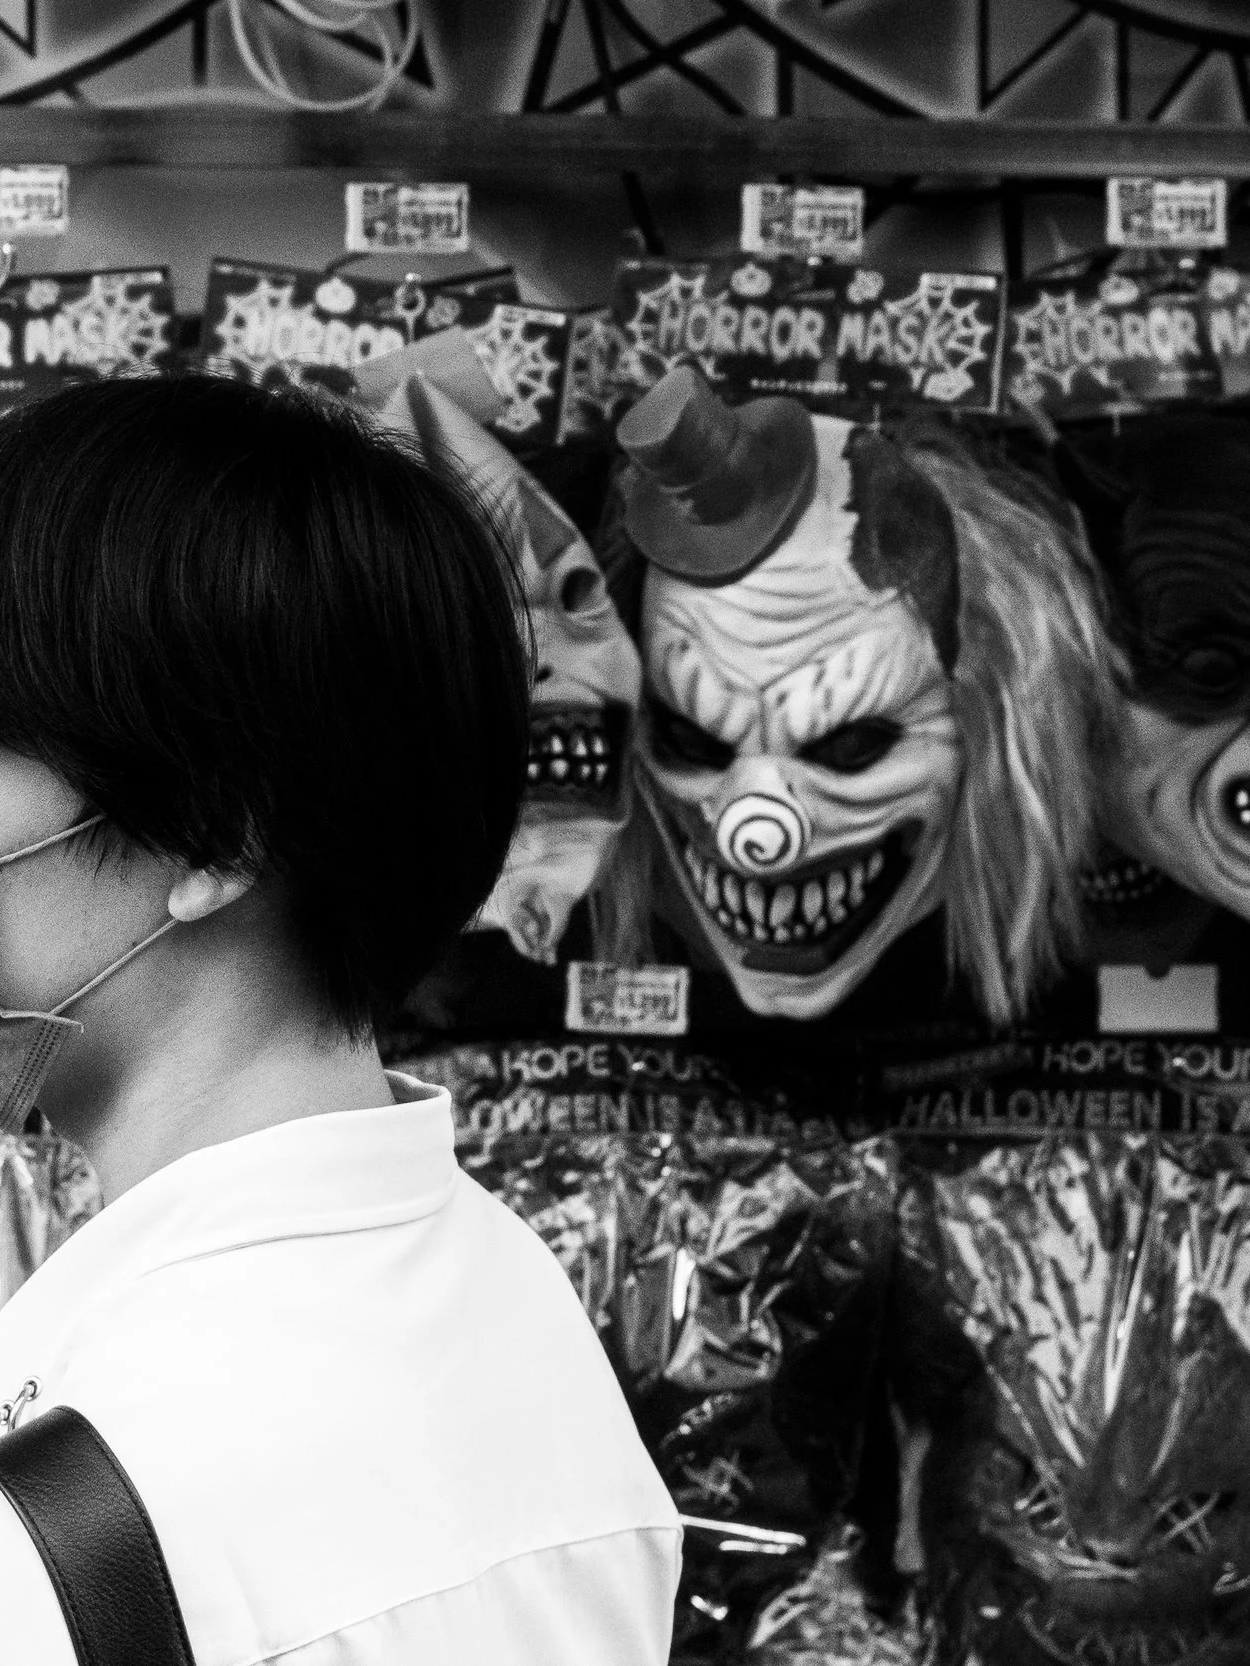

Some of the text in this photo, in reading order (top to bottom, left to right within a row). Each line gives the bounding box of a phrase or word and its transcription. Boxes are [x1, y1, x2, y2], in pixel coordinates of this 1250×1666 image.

[657, 304, 953, 367] HORROR MASK
[1044, 306, 1201, 365] HORROR
[1042, 1040, 1148, 1074] HOPE
[901, 1088, 1161, 1130] HALLOWEEN
